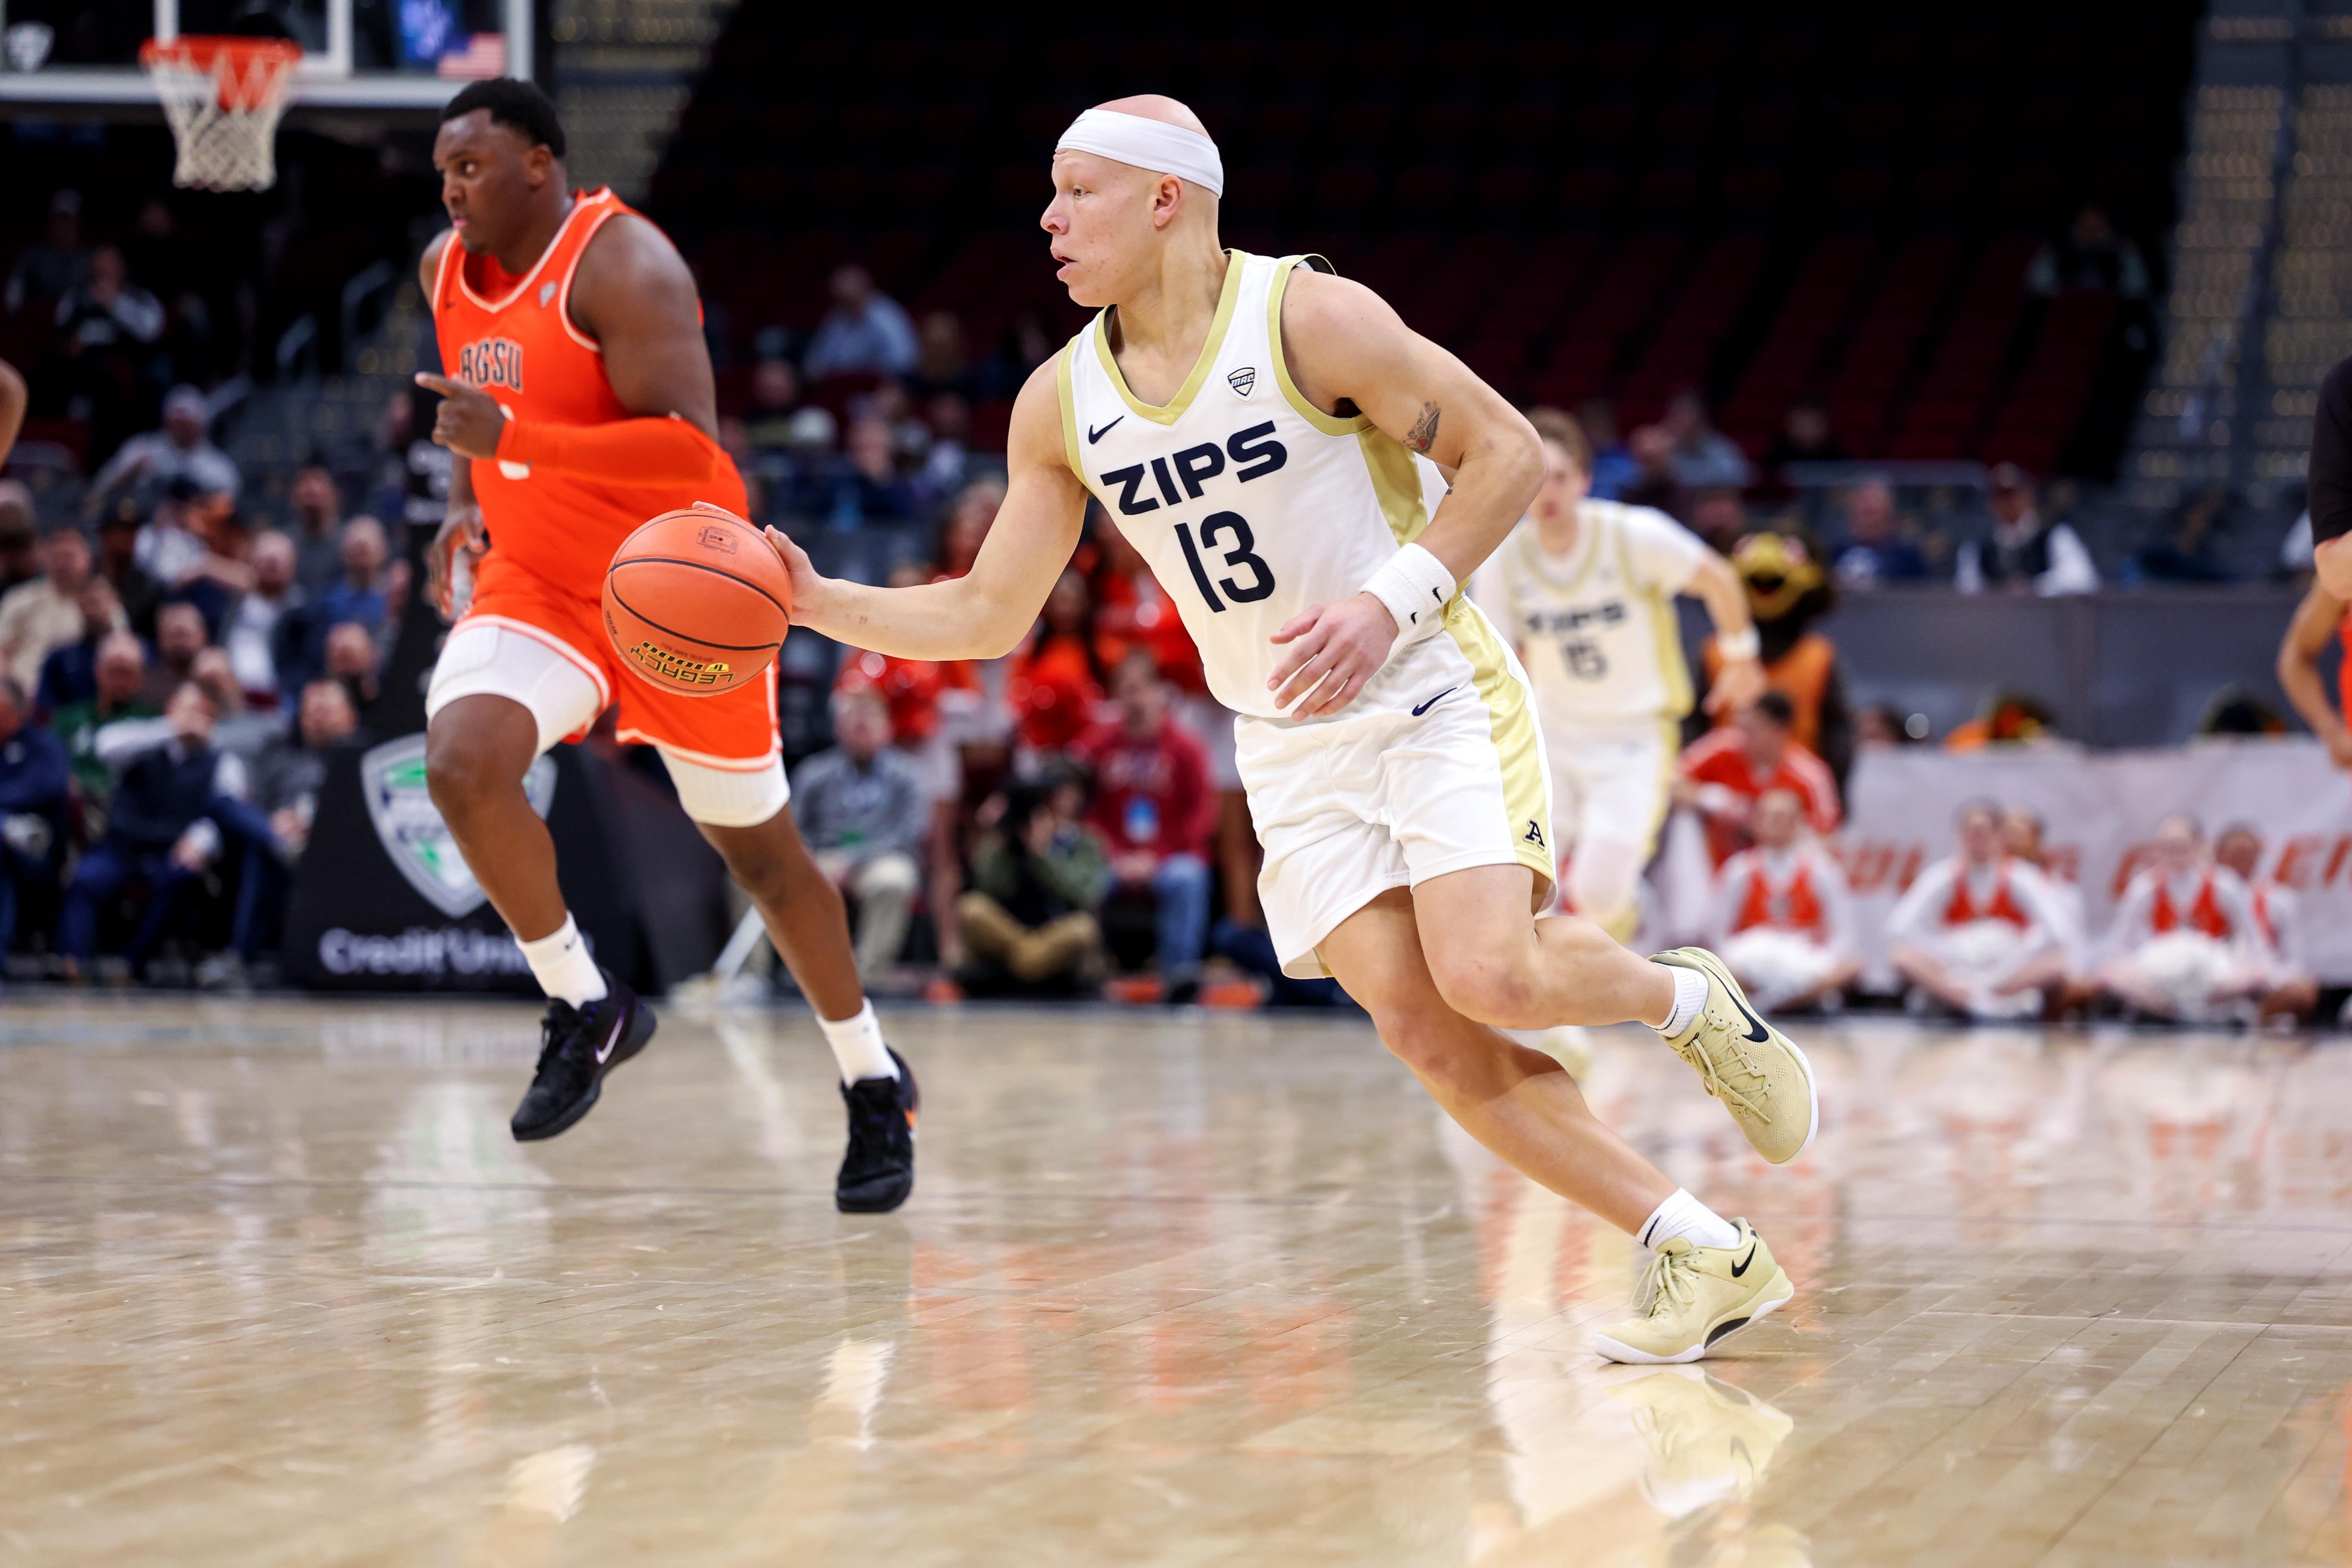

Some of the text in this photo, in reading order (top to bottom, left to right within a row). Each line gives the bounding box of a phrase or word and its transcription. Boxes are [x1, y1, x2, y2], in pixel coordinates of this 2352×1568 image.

[460, 337, 523, 394] BGSU
[1231, 374, 1255, 387] MAC
[1100, 421, 1287, 515] ZIPS
[1174, 511, 1275, 613] 13
[628, 645, 736, 685] LEGACY
[640, 640, 706, 672] 1000
[1524, 819, 1545, 850] A
